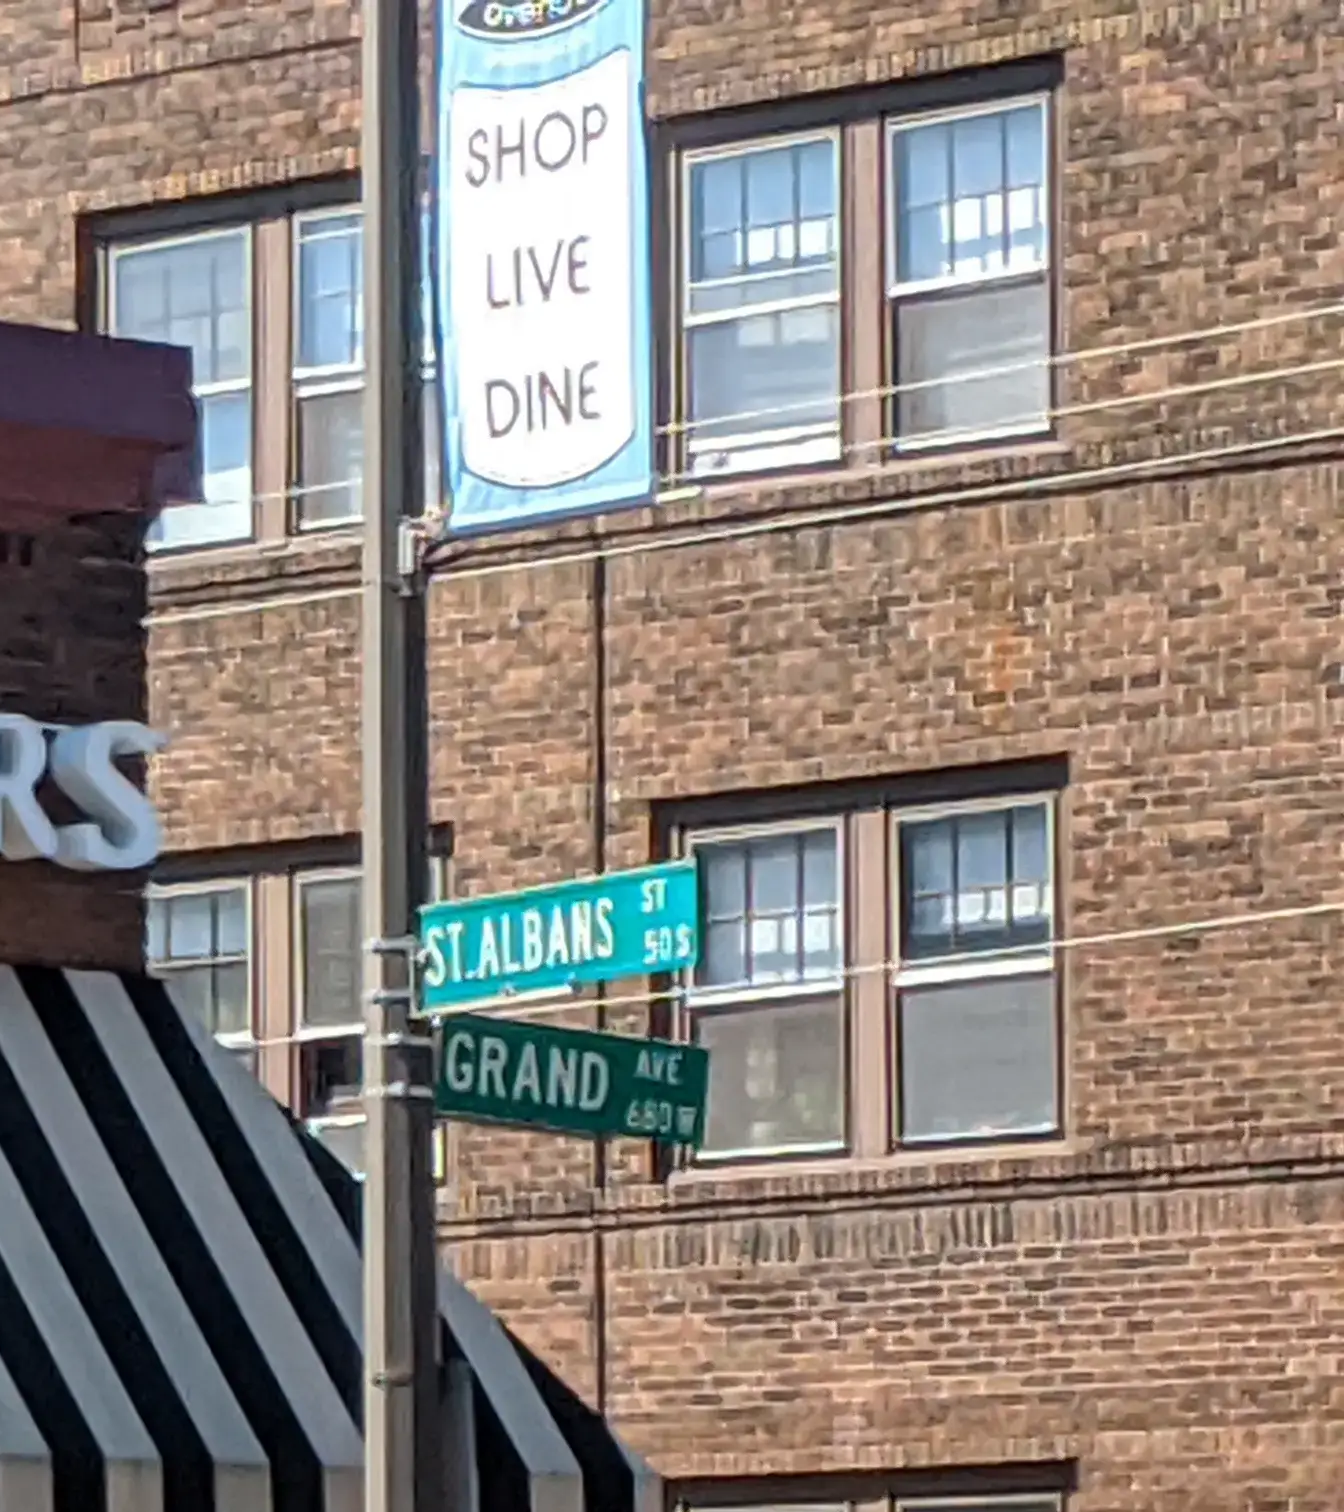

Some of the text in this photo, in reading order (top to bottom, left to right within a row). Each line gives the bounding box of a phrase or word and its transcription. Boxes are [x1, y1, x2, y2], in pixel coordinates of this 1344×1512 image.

[465, 103, 608, 188] SHOP
[486, 235, 591, 310] LIVE
[485, 361, 601, 439] DINE
[640, 878, 668, 914] ST
[445, 1031, 610, 1112] GRAND
[634, 1048, 684, 1086] AVE
